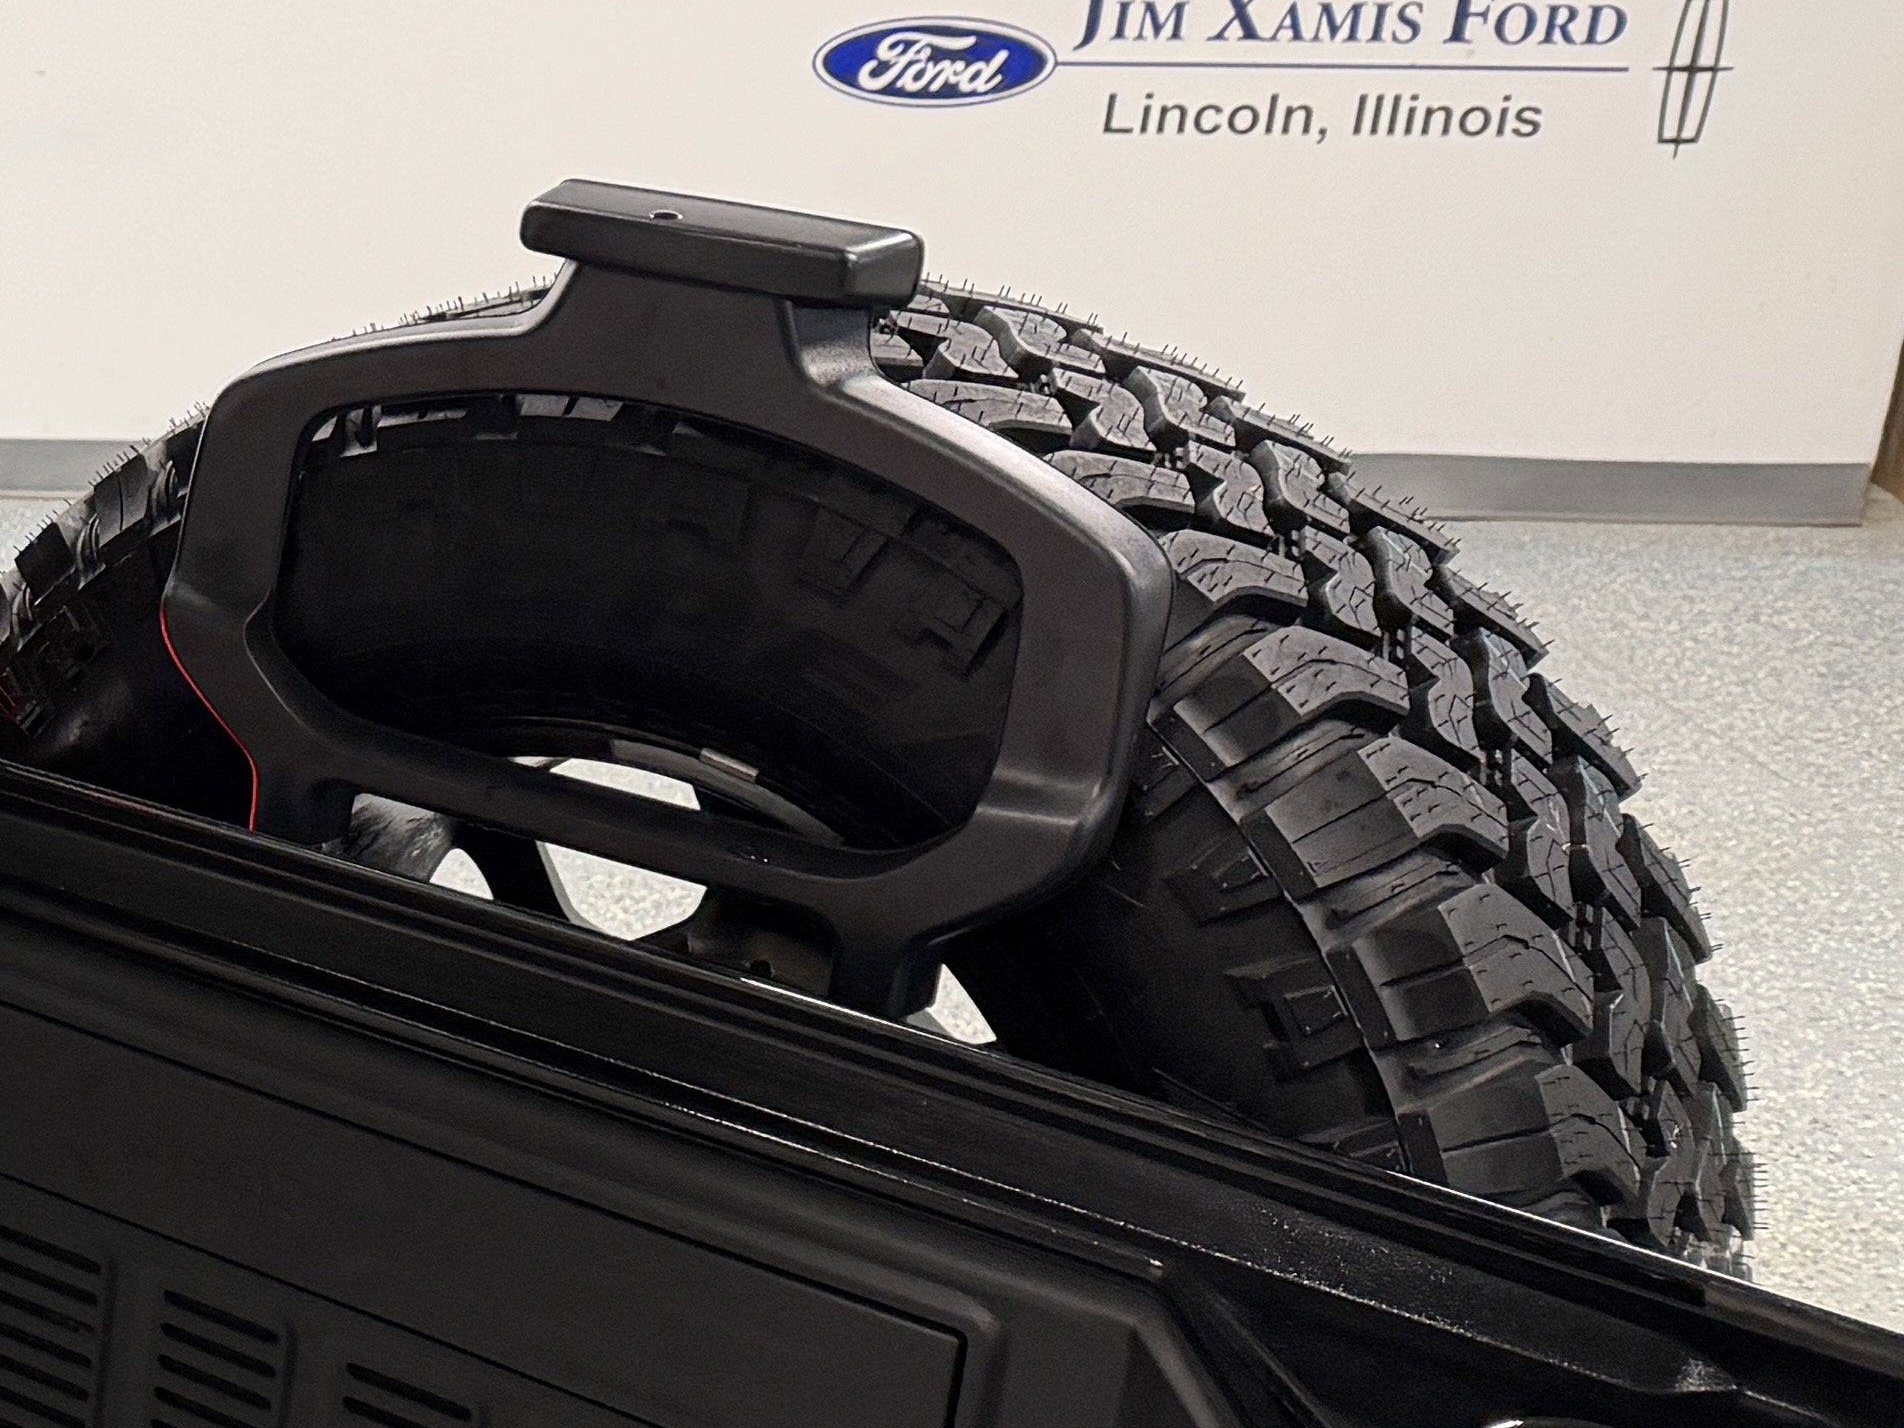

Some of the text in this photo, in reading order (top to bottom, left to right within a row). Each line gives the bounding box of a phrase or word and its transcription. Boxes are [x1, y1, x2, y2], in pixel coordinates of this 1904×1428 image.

[857, 30, 1010, 94] Ford
[1102, 93, 1543, 145] Lincoln, Illinois
